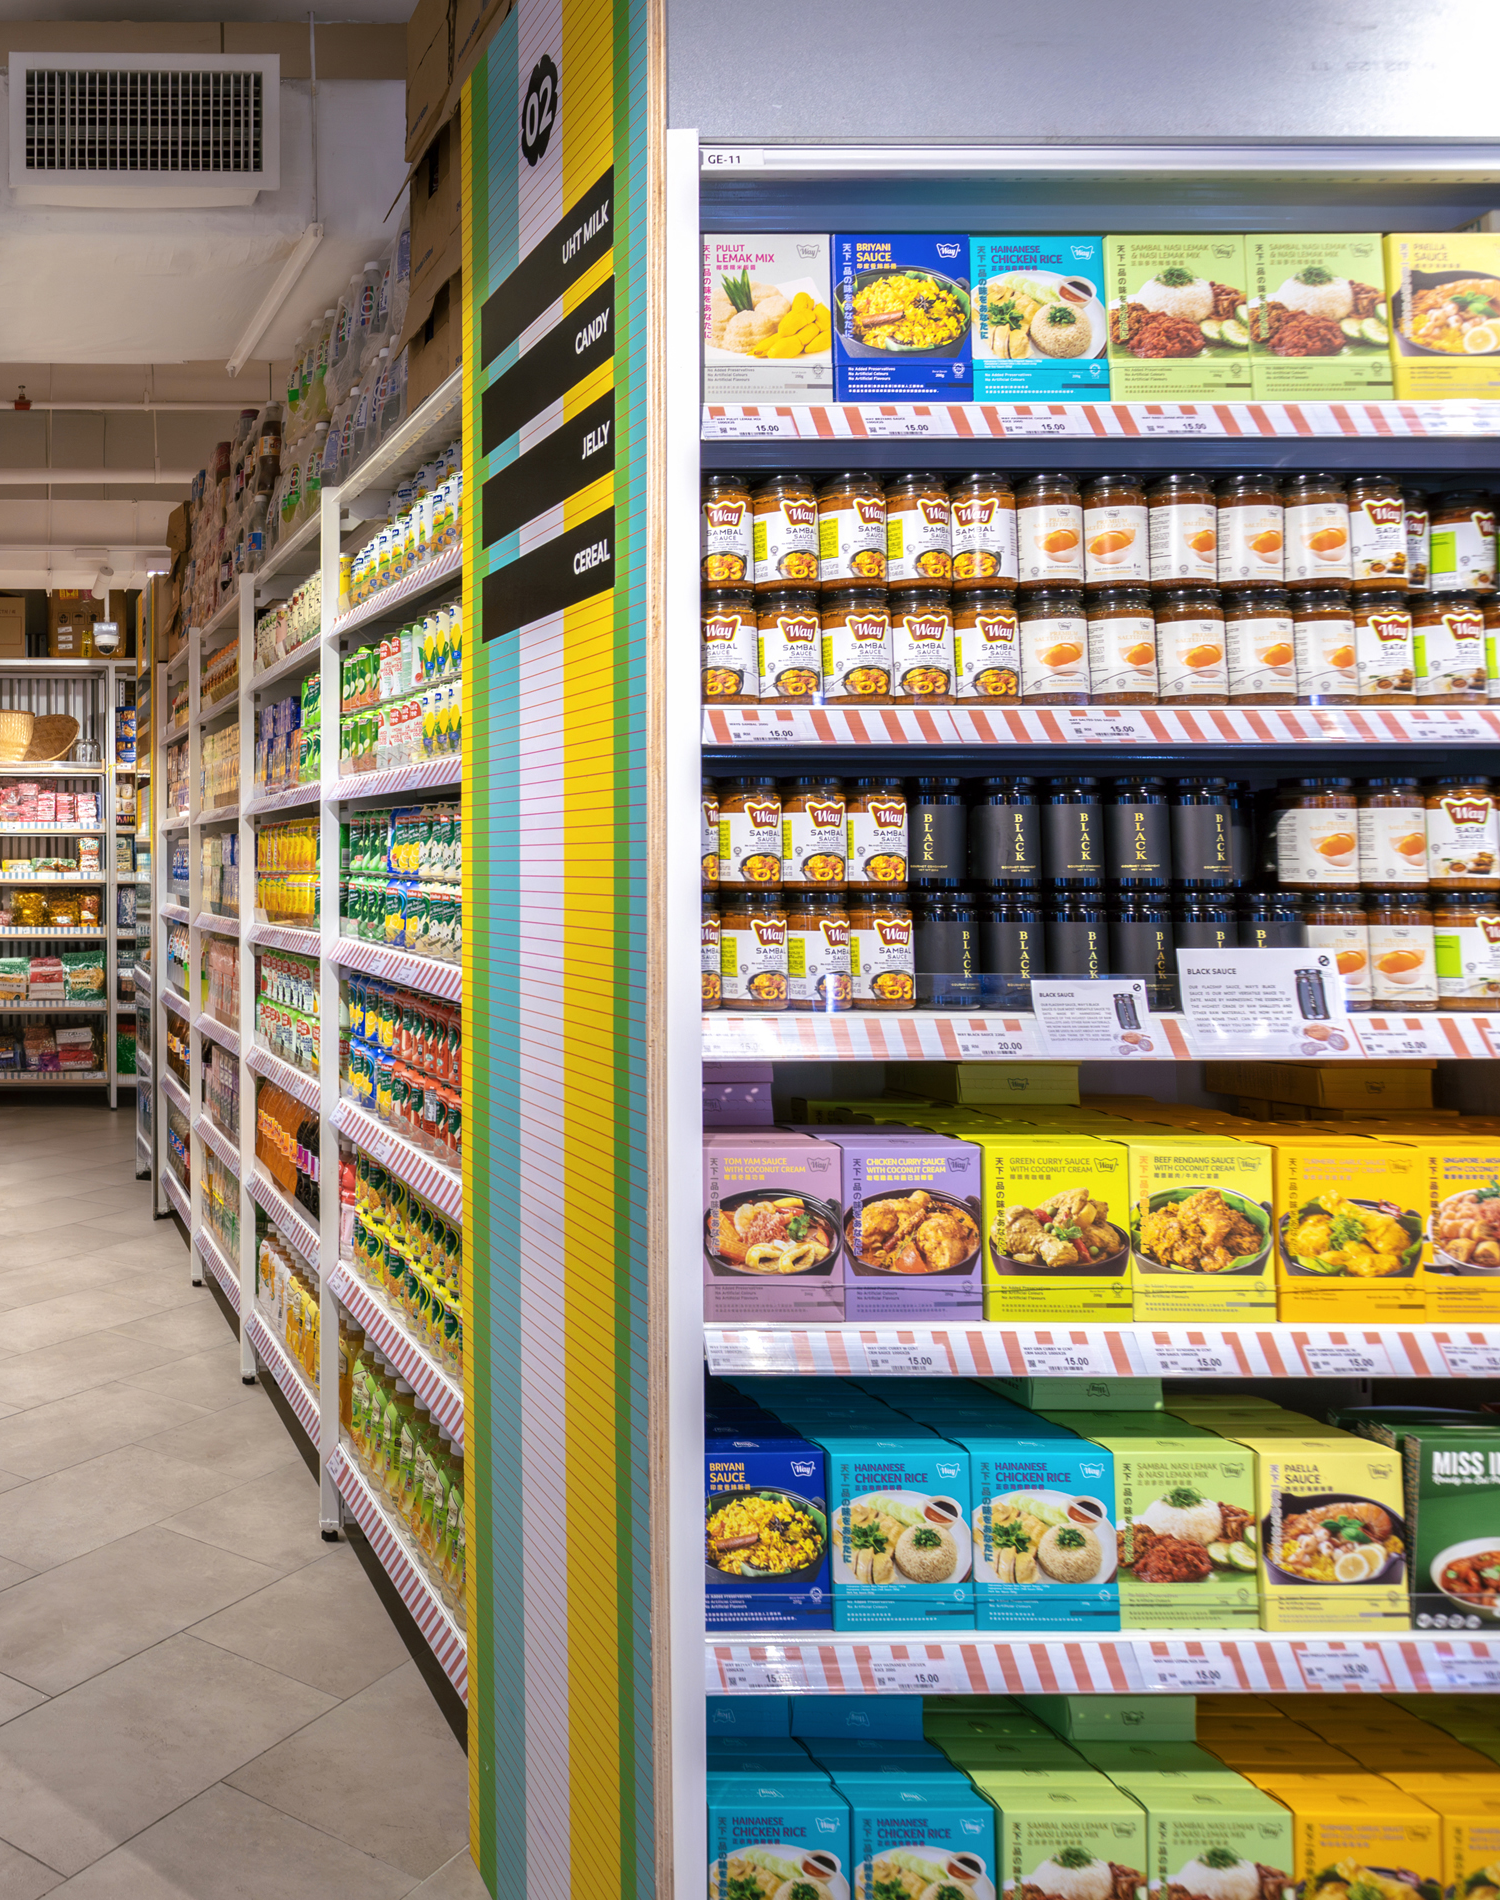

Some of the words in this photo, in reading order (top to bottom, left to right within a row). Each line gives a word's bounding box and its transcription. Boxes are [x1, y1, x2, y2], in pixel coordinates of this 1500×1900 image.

[526, 75, 552, 147] 02
[708, 155, 741, 164] GE-11
[562, 227, 582, 264] UHT
[583, 200, 610, 245] MILK
[801, 247, 816, 256] Way
[857, 243, 891, 251] BRIYANI
[717, 254, 753, 262] LEMAK
[755, 254, 775, 262] MIX
[857, 252, 892, 261] SAUCE
[991, 255, 1037, 263] CHICKEN
[1040, 255, 1063, 263] RICE
[575, 307, 610, 354] CANDY
[1041, 423, 1065, 432] 15.00
[582, 420, 611, 460] JELLY
[709, 507, 740, 523] Way
[706, 529, 743, 537] SAMBAL
[573, 539, 611, 575] CEREAL
[855, 622, 884, 639] Way
[912, 622, 943, 639] Way
[851, 642, 887, 651] SAMBAL
[908, 642, 946, 651] SAMBAL
[769, 729, 794, 738] 15.00
[814, 810, 841, 827] Way
[1451, 807, 1487, 822] Way
[810, 829, 844, 837] SAMBAL
[1014, 813, 1025, 861] BLACK
[1134, 812, 1147, 860] BLACK
[1215, 813, 1225, 861] BLACK
[882, 927, 909, 944] Way
[878, 947, 912, 955] SAMBAL
[962, 931, 972, 979] BLACK
[1088, 931, 1099, 979] BLACK
[1155, 931, 1167, 979] BLACK
[998, 1042, 1022, 1050] 20.00
[1402, 1041, 1427, 1050] 15.00
[724, 1157, 739, 1165] TOM
[741, 1157, 760, 1165] YAM
[762, 1157, 787, 1165] SAUCE
[866, 1158, 897, 1166] CHICKEN
[898, 1158, 921, 1166] CURRY
[922, 1158, 945, 1166] SAUCE
[1154, 1156, 1172, 1164] BEEF
[1174, 1156, 1209, 1165] RENDANG
[1211, 1156, 1235, 1165] SAUCE
[745, 1165, 779, 1173] COCONUT
[781, 1165, 806, 1173] CREAM
[1154, 1164, 1172, 1172] WITH
[1174, 1164, 1208, 1172] COCONUT
[1210, 1164, 1236, 1172] CREAM
[908, 1357, 932, 1365] 15.00
[1065, 1357, 1089, 1366] 15.00
[1197, 1358, 1222, 1366] 15.00
[709, 1463, 745, 1472] BRIYANI
[854, 1463, 905, 1472] HAINANESE
[1433, 1451, 1484, 1475] MISS
[1284, 1464, 1319, 1474] PAELLA
[710, 1472, 746, 1482] SAUCE
[855, 1473, 900, 1483] CHICKEN
[904, 1473, 928, 1483] RICE
[1284, 1474, 1321, 1485] SAUCE
[915, 1674, 939, 1683] 15.00
[732, 1817, 784, 1826] HAINANESE
[732, 1827, 781, 1837] CHICKEN
[783, 1827, 807, 1837] RICE
